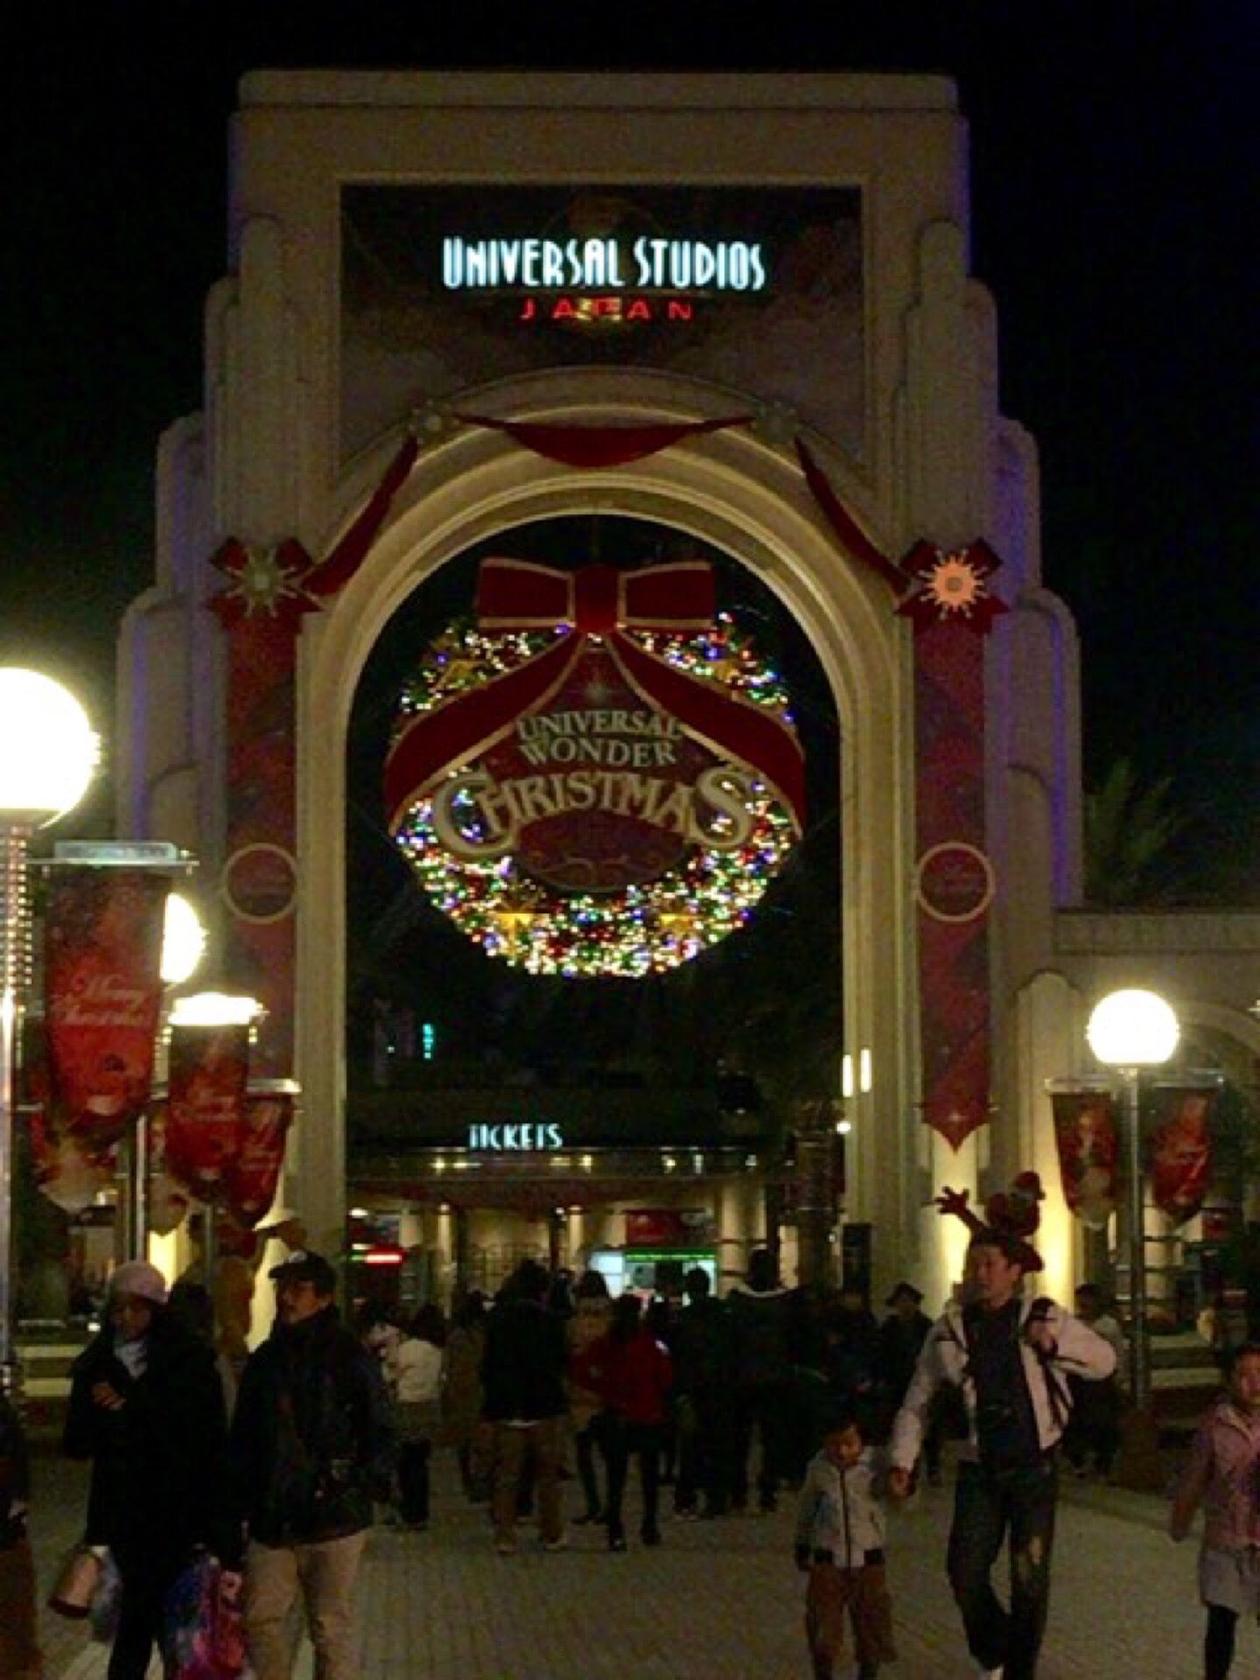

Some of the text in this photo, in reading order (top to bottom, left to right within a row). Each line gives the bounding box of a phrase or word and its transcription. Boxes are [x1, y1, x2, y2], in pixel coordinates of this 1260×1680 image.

[443, 235, 766, 291] UNIVERSAL STUDIOS
[520, 297, 693, 321] JAPAN
[516, 710, 684, 741] UNIVERSAL
[519, 737, 678, 768] WONDER
[435, 763, 755, 856] CHRISTMAS
[468, 1122, 563, 1150] TICKETS
